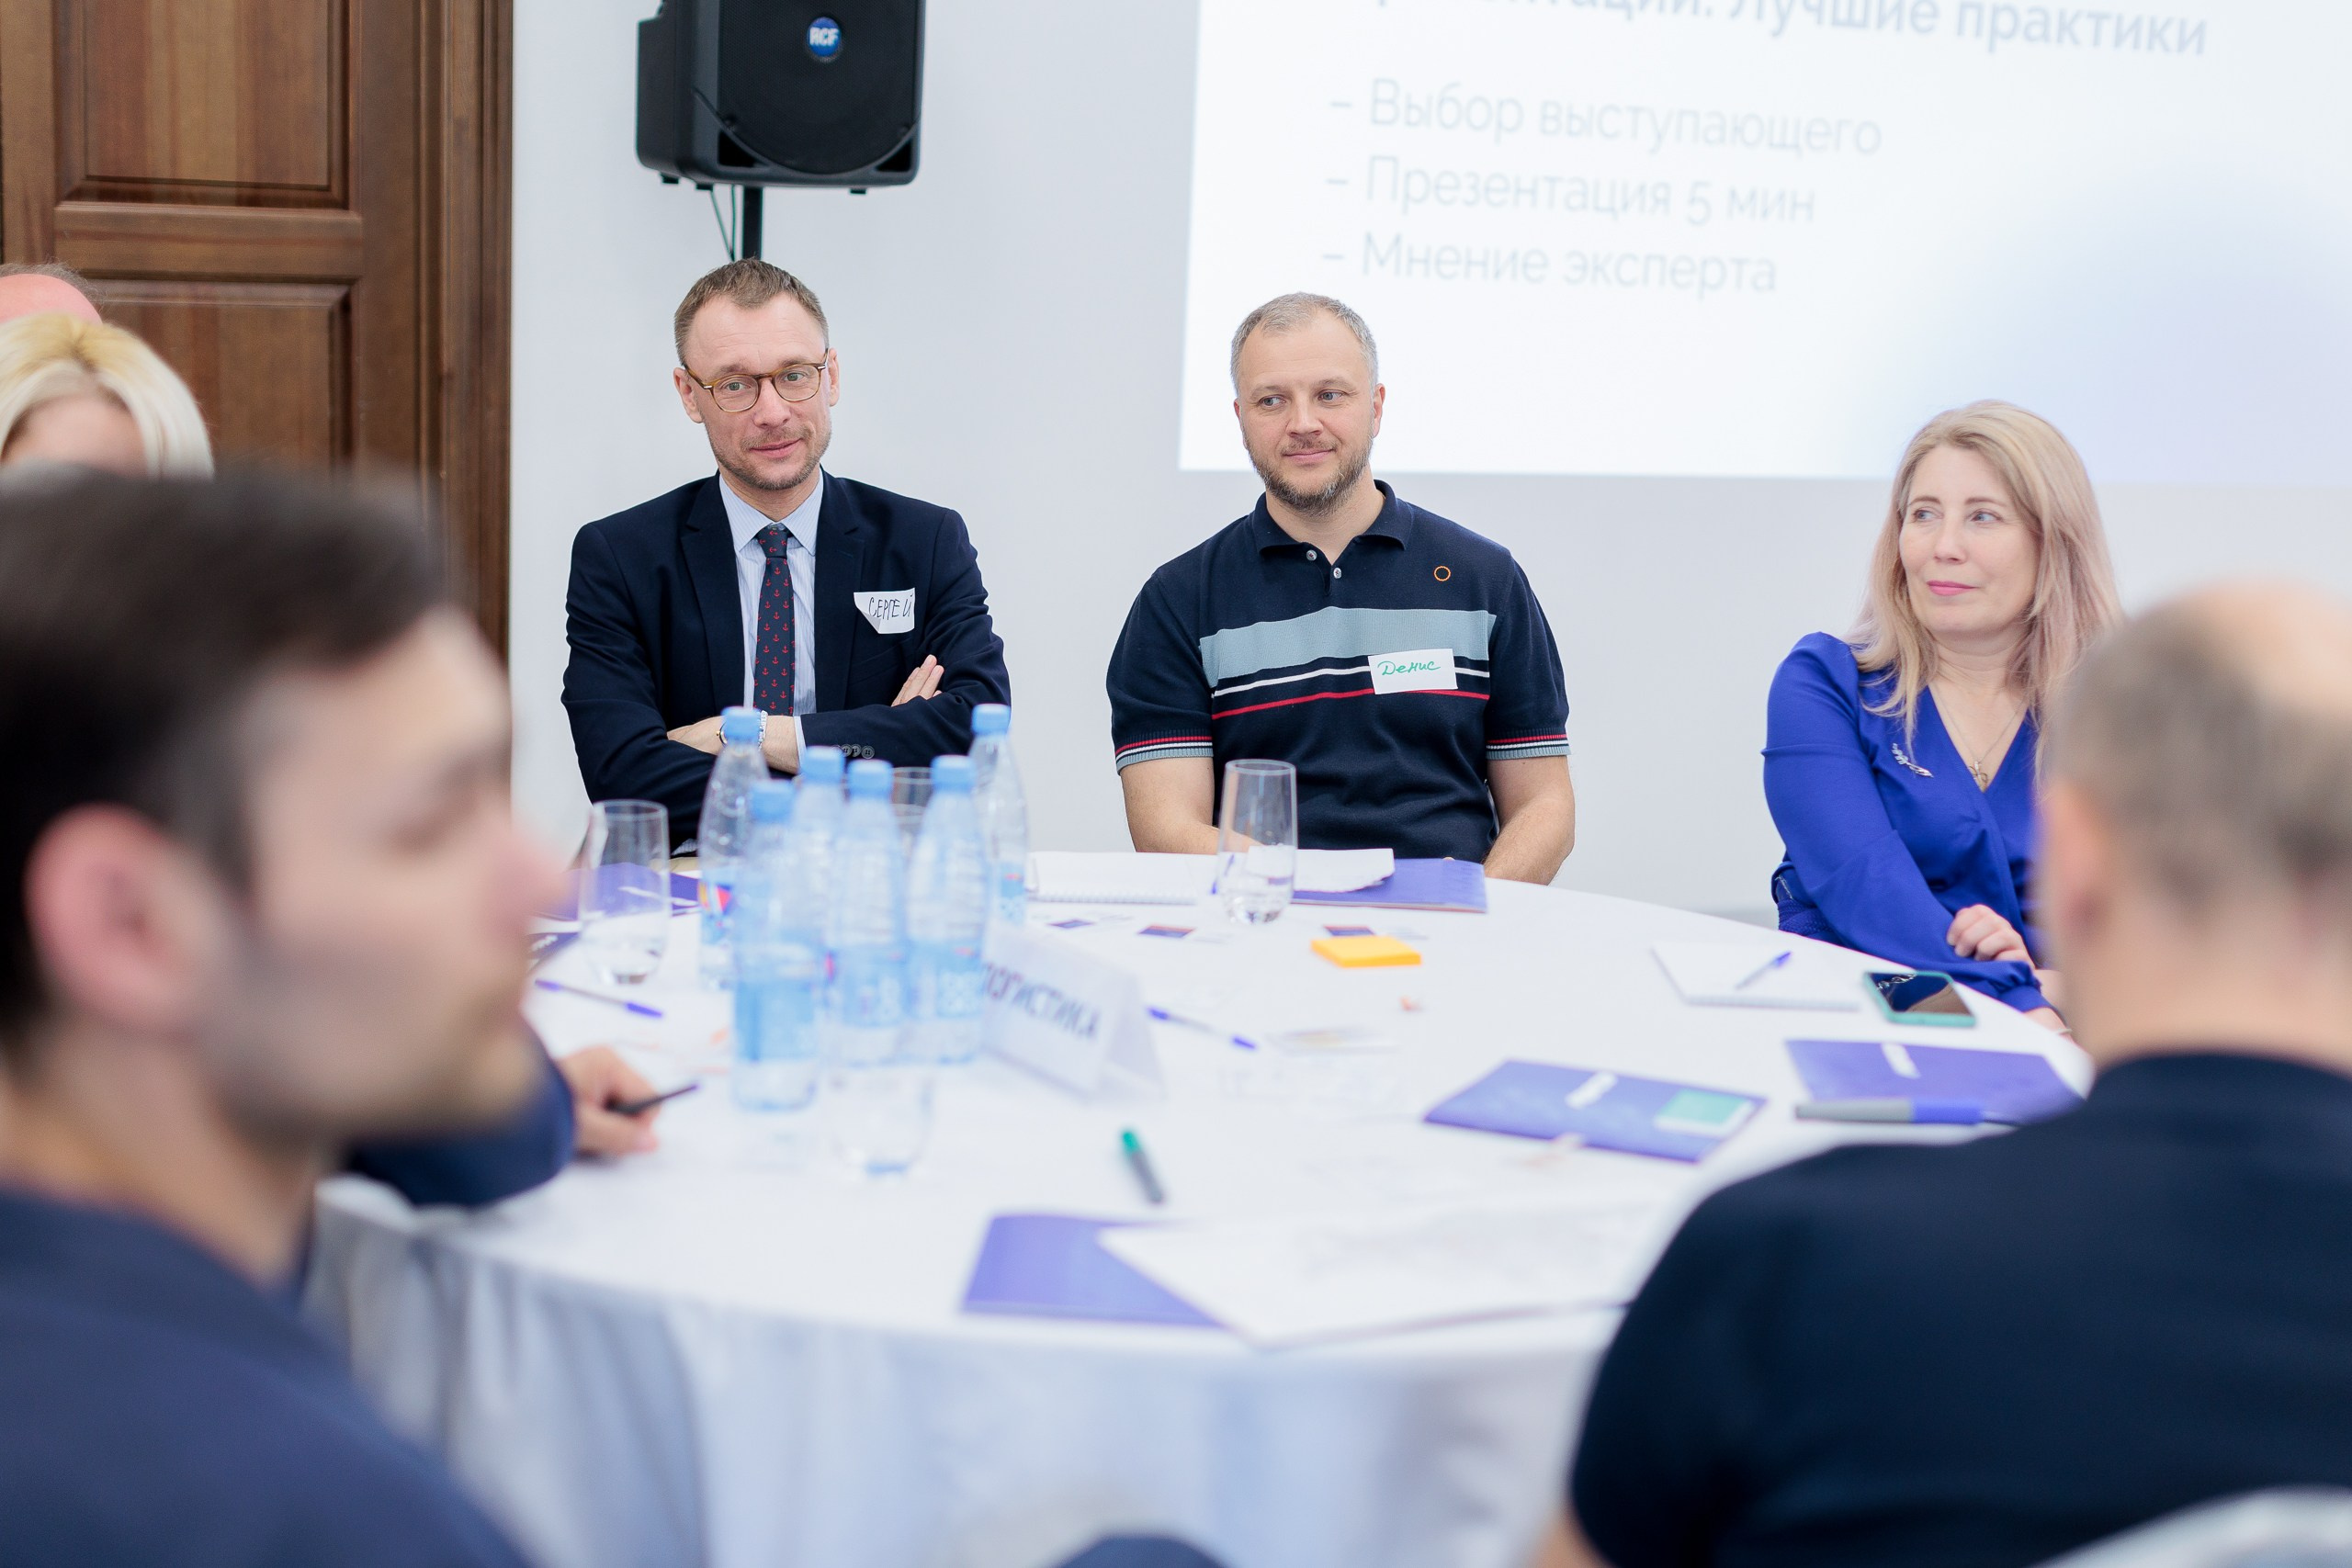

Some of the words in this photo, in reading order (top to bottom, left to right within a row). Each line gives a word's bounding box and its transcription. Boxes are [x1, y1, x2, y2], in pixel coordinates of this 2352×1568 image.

[809, 27, 839, 46] RCF
[1956, 1, 2207, 56] практики
[1369, 77, 1525, 146] Выбор
[1538, 98, 1883, 158] выступающего
[1364, 153, 1672, 221] Презентация
[1685, 179, 1713, 227] 5
[1725, 184, 1816, 224] мин
[1361, 230, 1550, 284] Мнение
[1562, 249, 1779, 301] эксперта
[1377, 660, 1442, 676] Денис
